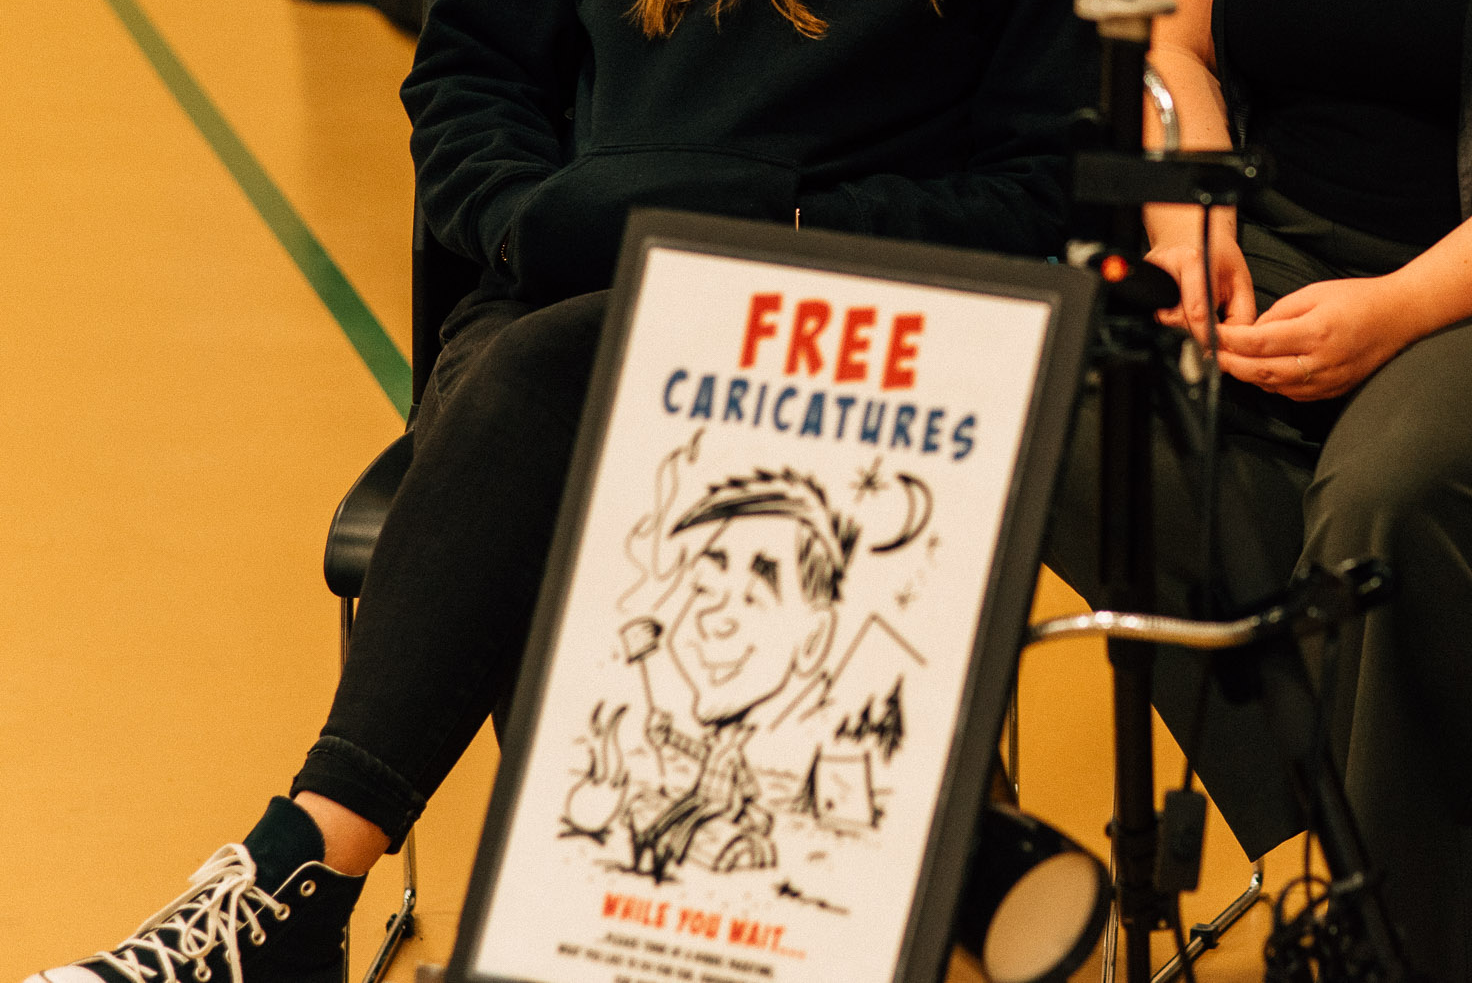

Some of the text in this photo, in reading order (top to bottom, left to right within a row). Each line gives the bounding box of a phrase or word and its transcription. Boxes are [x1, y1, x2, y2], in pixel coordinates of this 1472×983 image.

[738, 292, 926, 390] FREE
[662, 368, 978, 461] CARICATURES
[602, 892, 670, 930] WHILE
[676, 907, 722, 940] YOU
